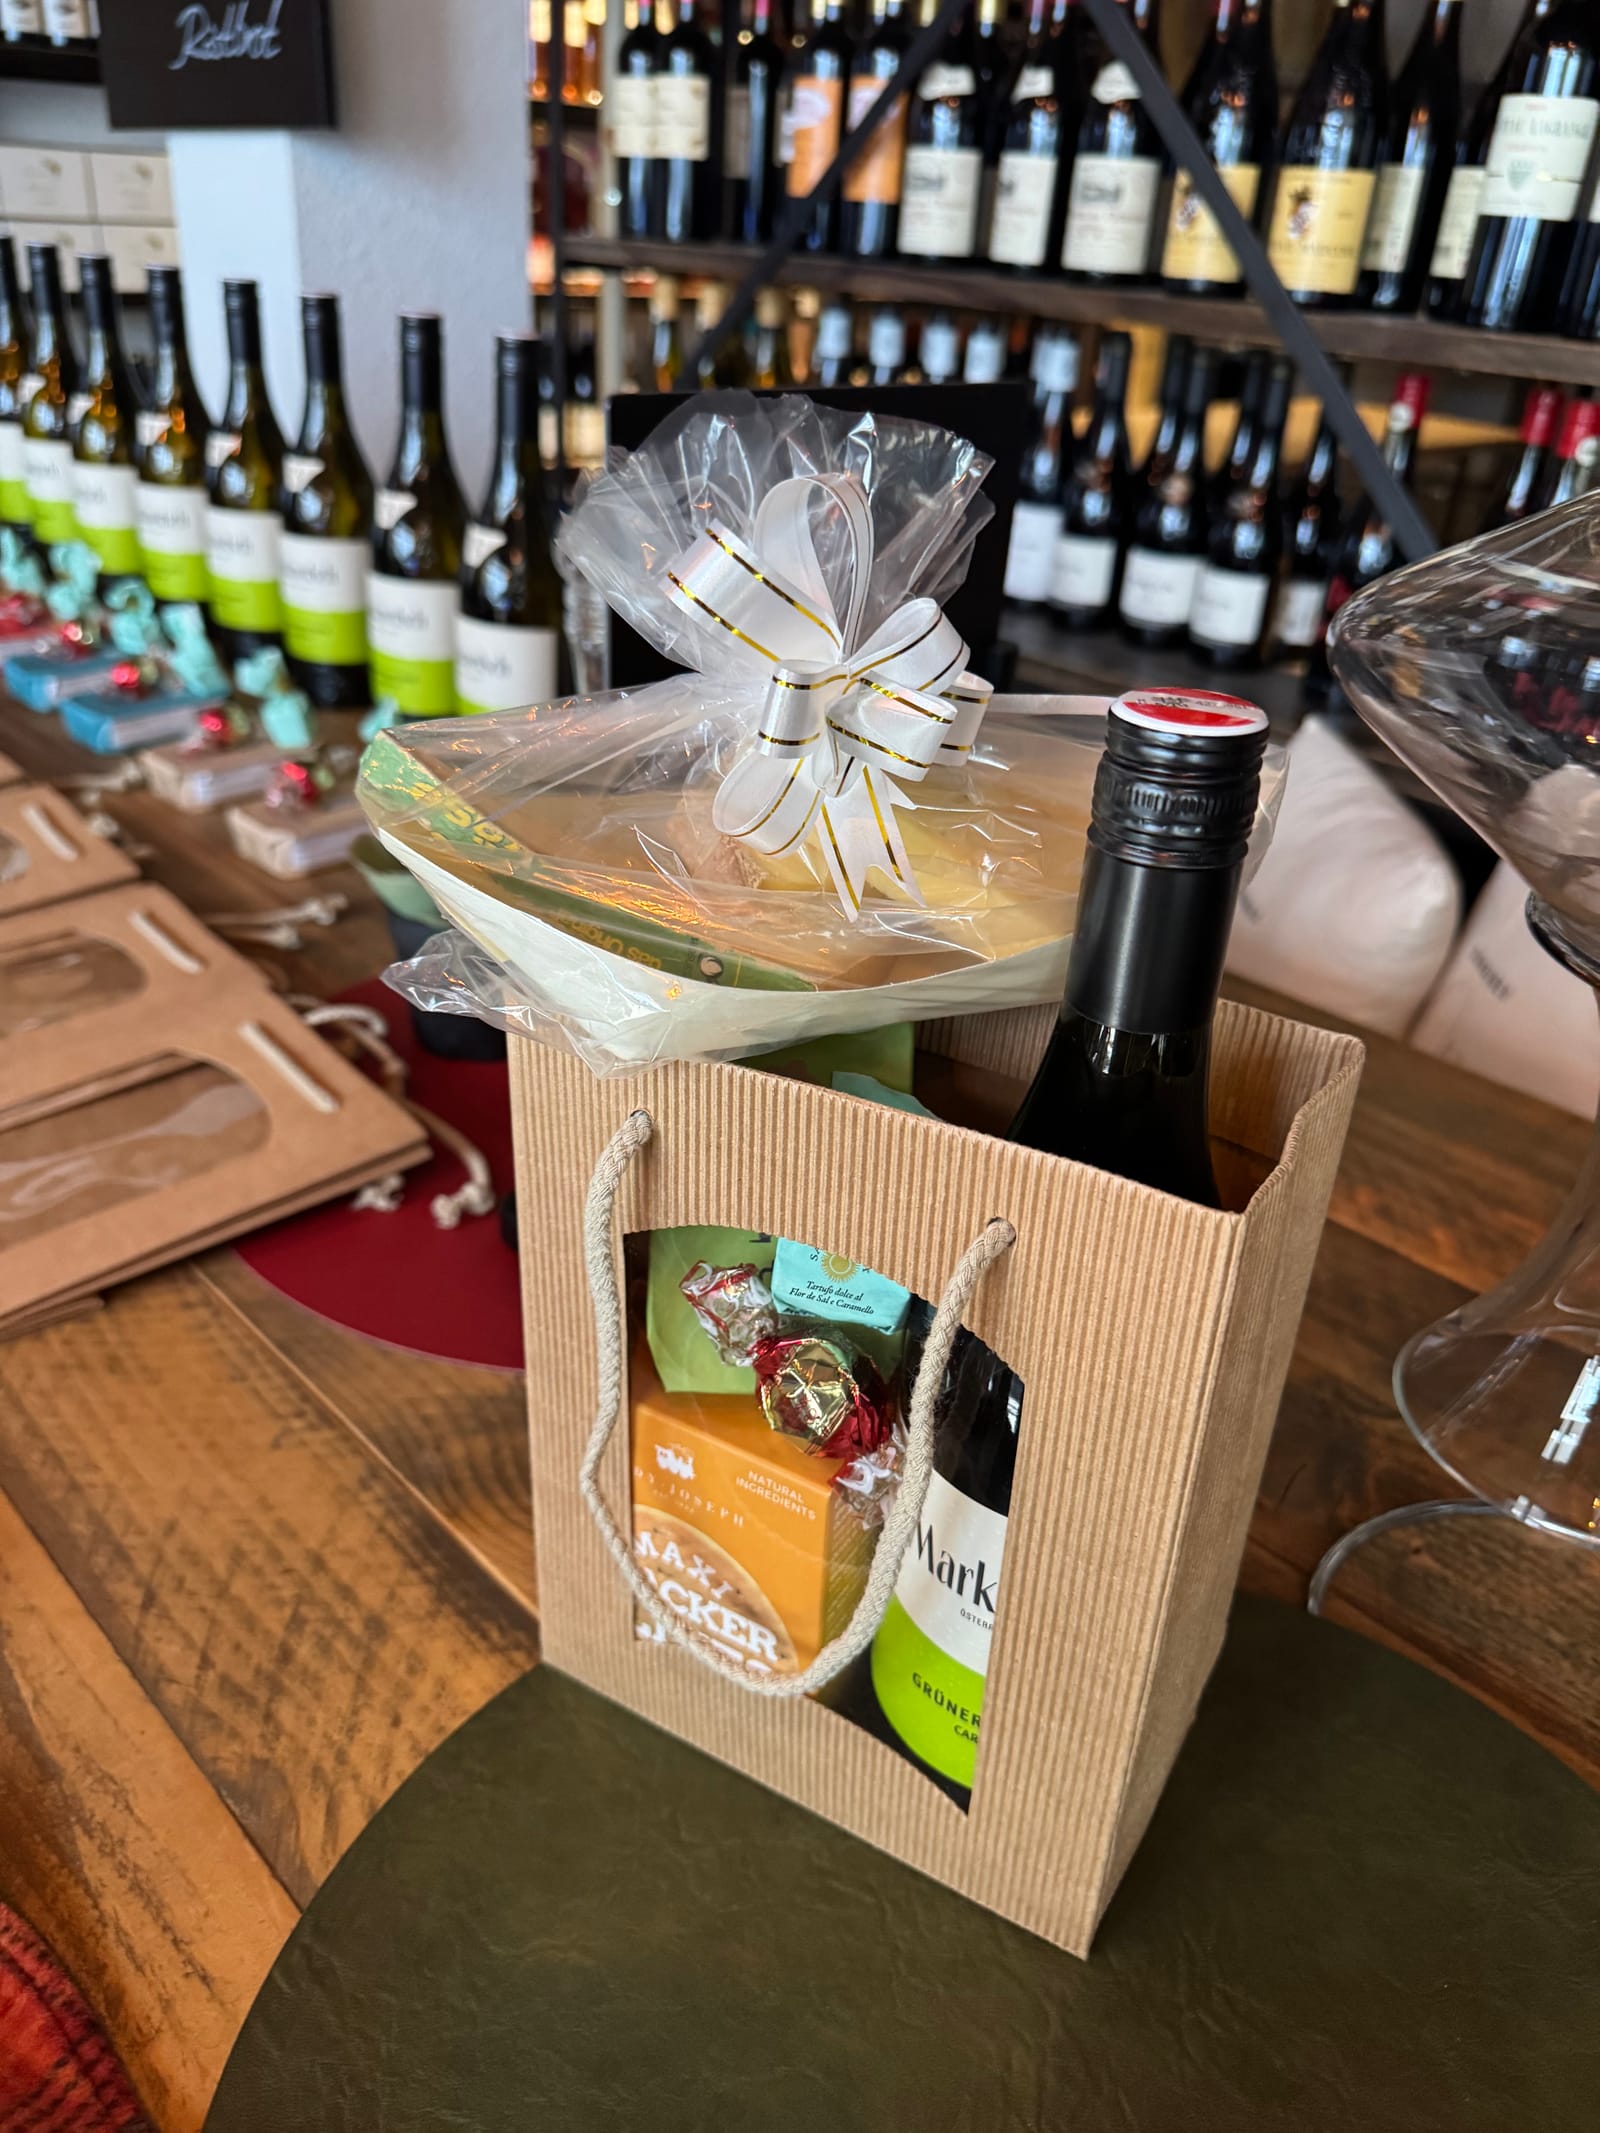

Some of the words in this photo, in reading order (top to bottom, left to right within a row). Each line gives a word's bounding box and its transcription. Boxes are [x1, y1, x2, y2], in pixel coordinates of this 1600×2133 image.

[789, 1287, 805, 1298] Flor
[806, 1291, 815, 1300] de
[816, 1293, 829, 1304] Sal
[836, 1299, 875, 1315] Caramello
[806, 1280, 833, 1296] Tartufo
[835, 1287, 854, 1300] dolce
[854, 1292, 864, 1301] al
[735, 1476, 817, 1521] INGREDIENTS
[748, 1470, 805, 1504] NATURAL
[633, 1531, 734, 1600] MAXI
[912, 1671, 981, 1728] GRÜNER
